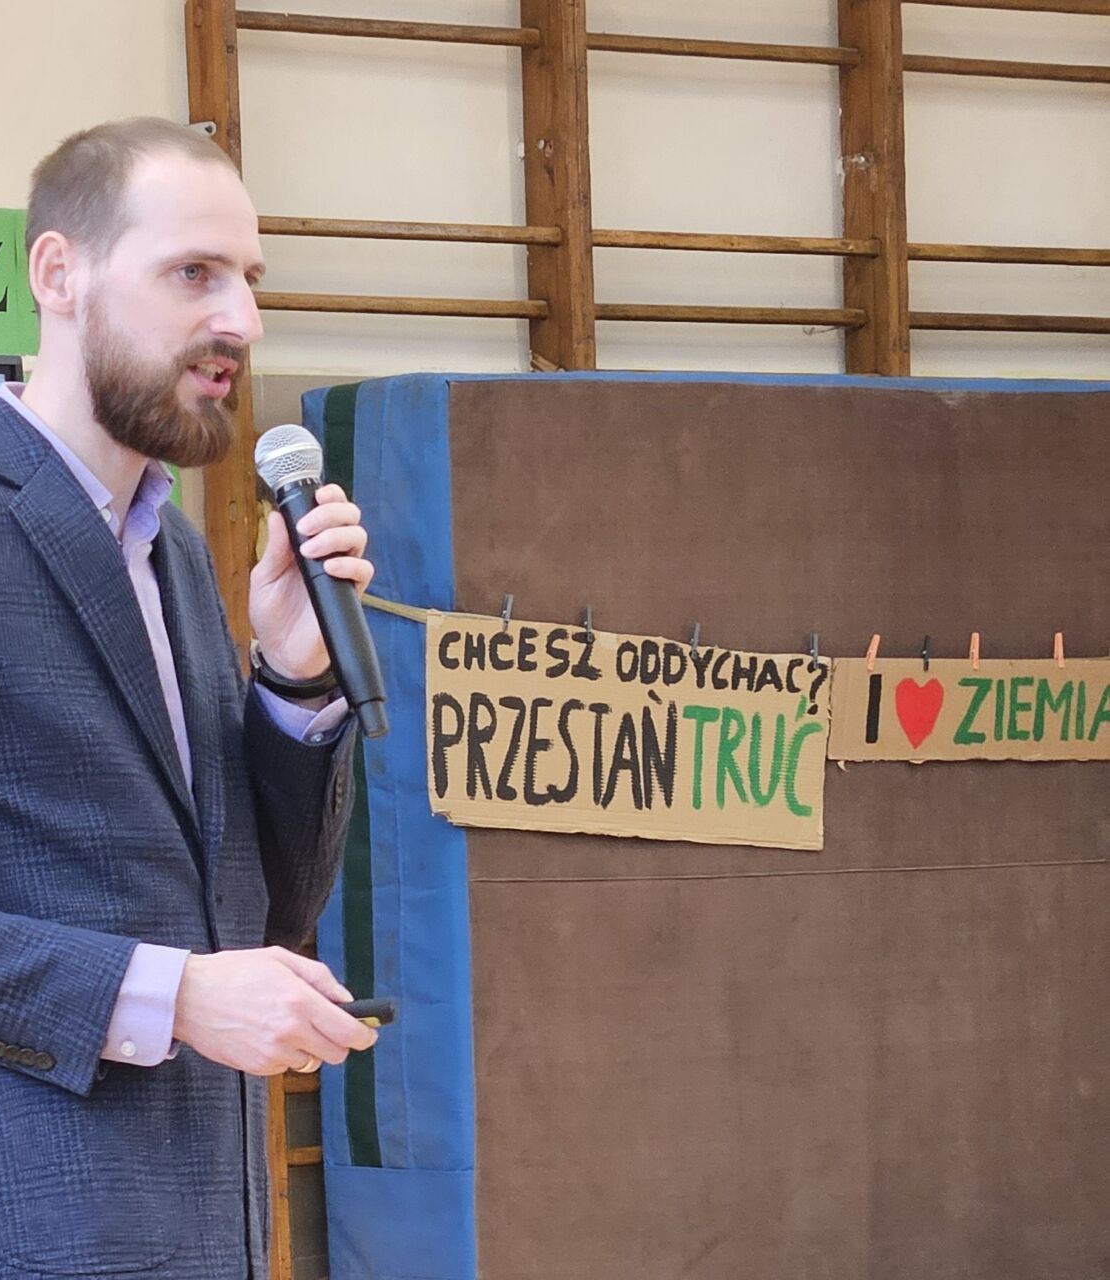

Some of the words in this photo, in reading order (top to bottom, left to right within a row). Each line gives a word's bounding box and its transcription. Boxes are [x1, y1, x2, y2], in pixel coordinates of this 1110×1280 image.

[438, 626, 603, 681] CHCESZ
[866, 673, 882, 744] I
[682, 694, 823, 816] TRUĆ
